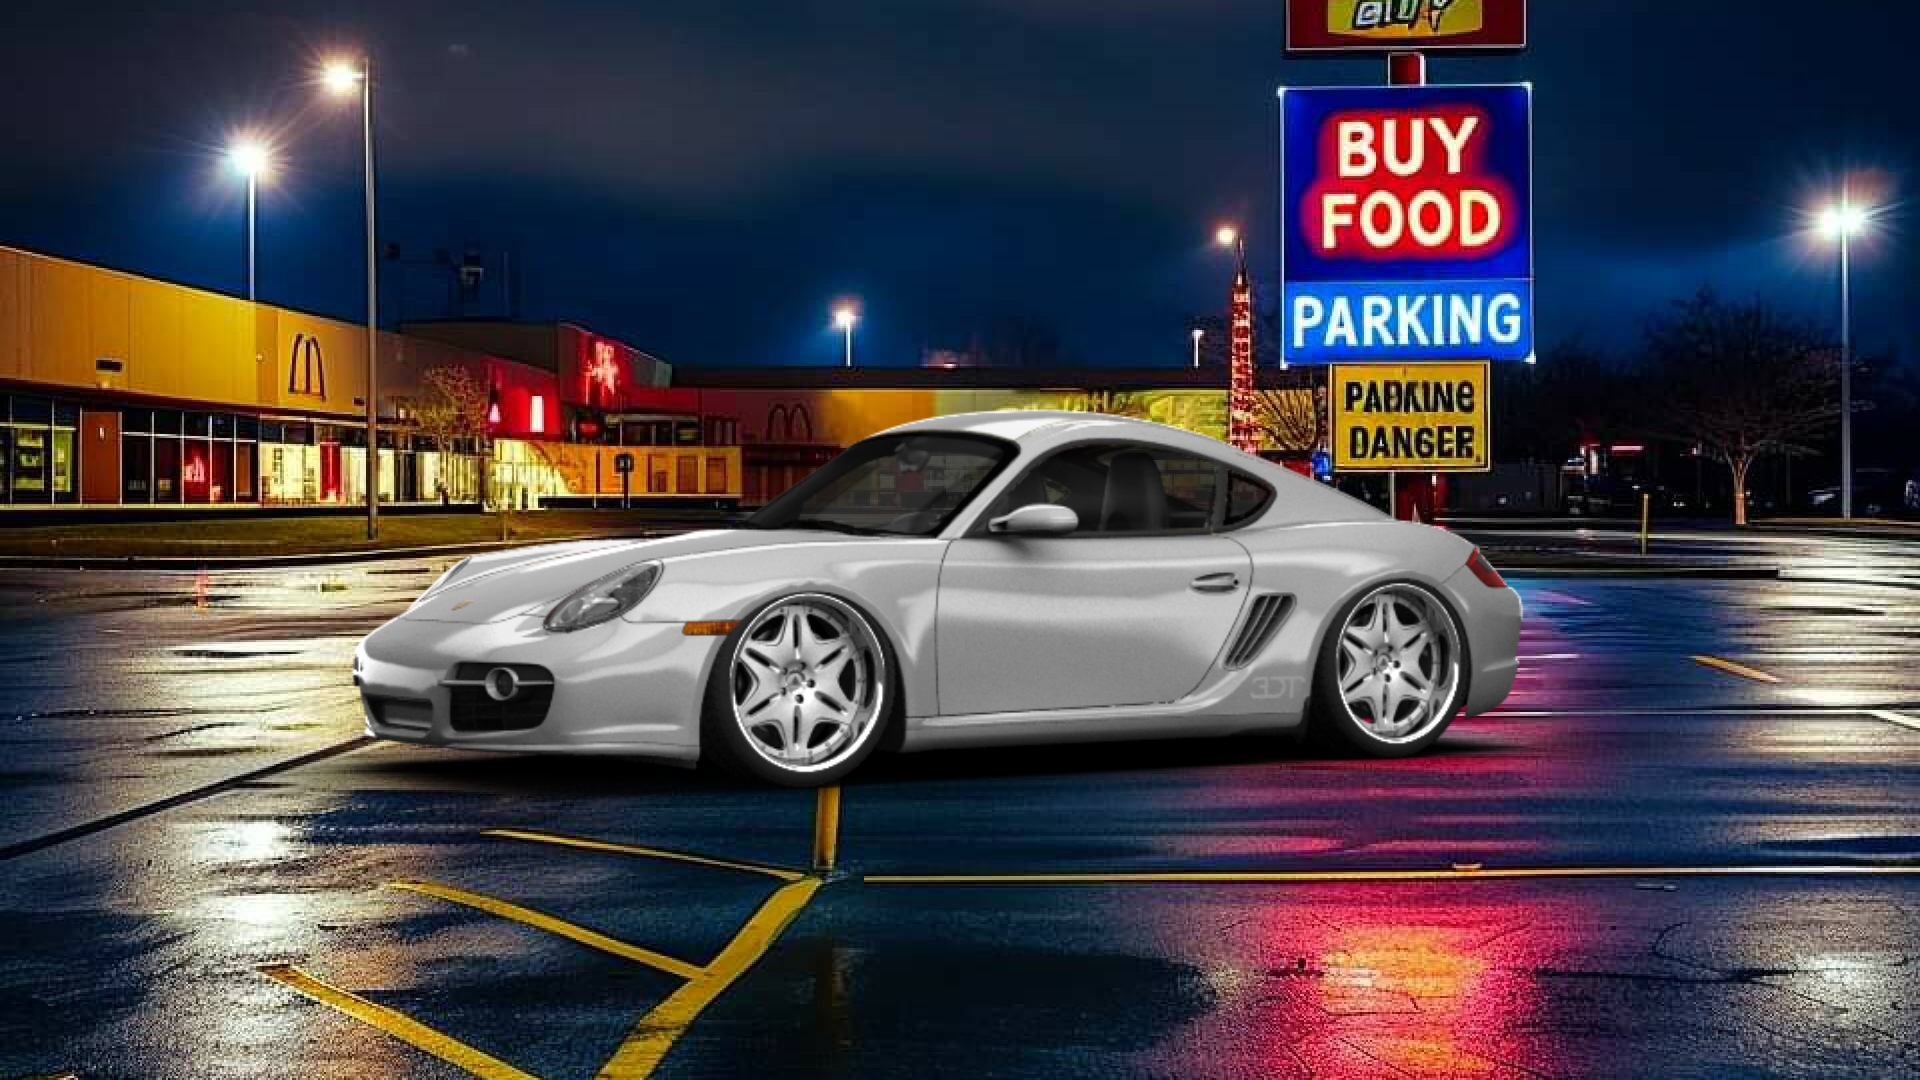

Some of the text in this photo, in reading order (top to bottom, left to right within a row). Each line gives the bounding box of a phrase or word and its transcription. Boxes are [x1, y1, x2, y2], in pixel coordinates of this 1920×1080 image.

[1338, 115, 1480, 178] BUY
[1321, 189, 1502, 249] FOOD
[1293, 292, 1521, 348] PARKING
